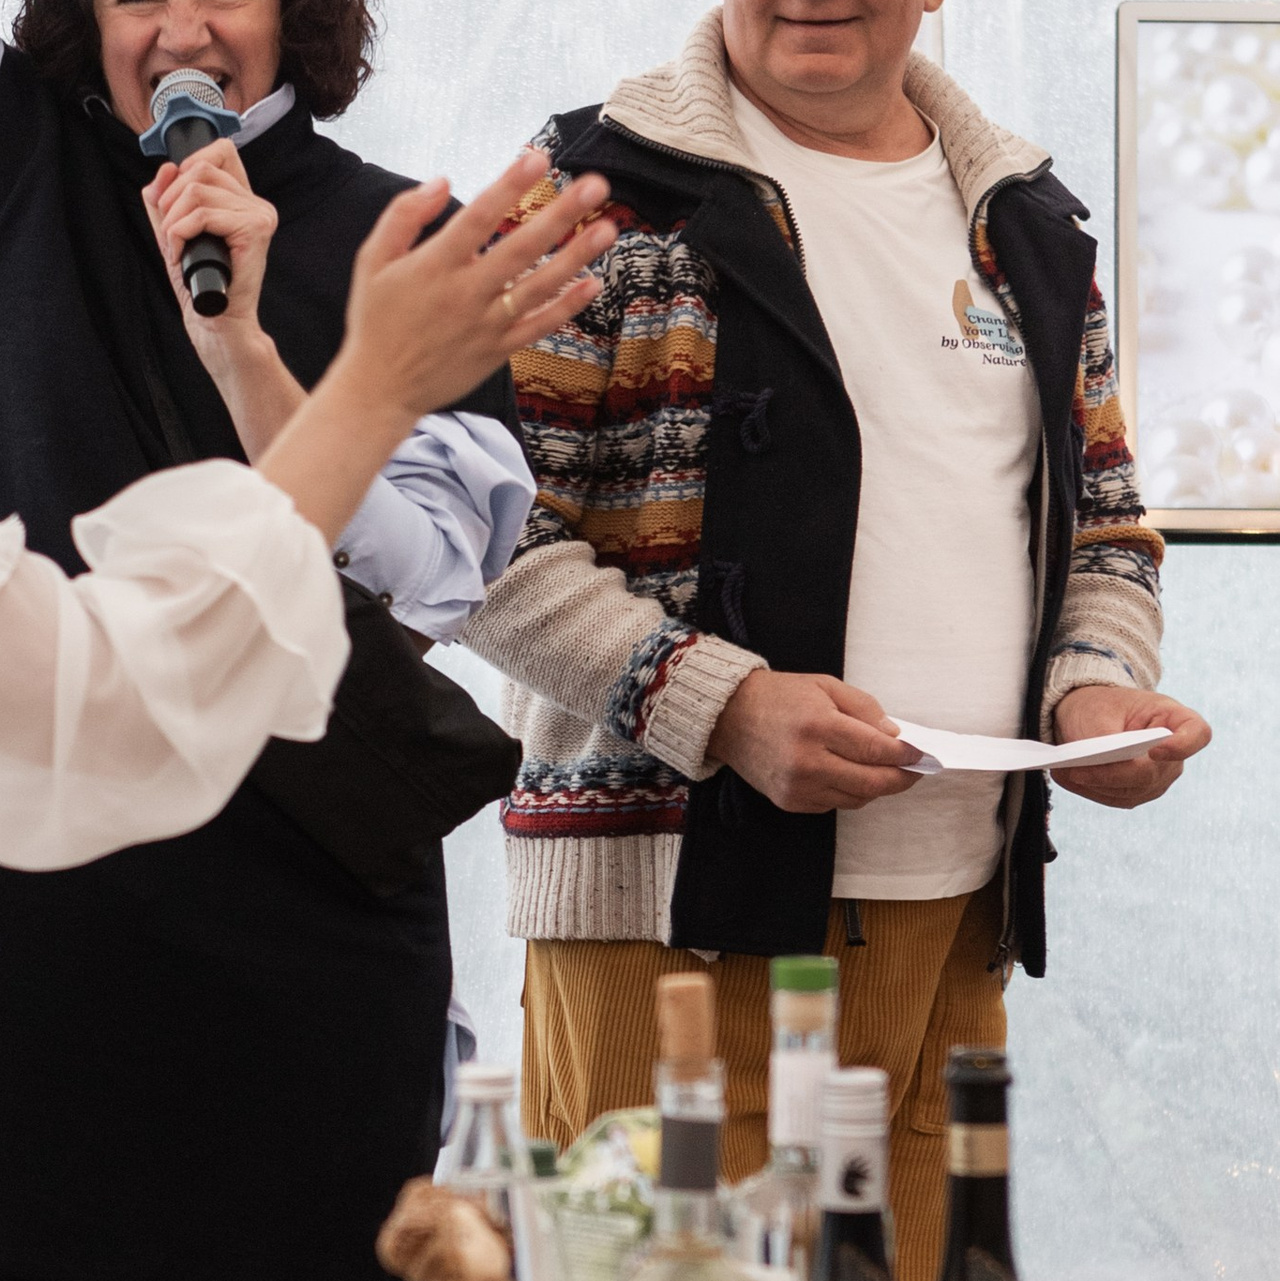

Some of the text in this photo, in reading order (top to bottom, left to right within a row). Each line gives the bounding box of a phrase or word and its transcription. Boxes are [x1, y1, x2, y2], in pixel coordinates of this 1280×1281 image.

[963, 325, 994, 337] Your
[941, 336, 1024, 356] by Observing
[982, 354, 1027, 367] Nature
